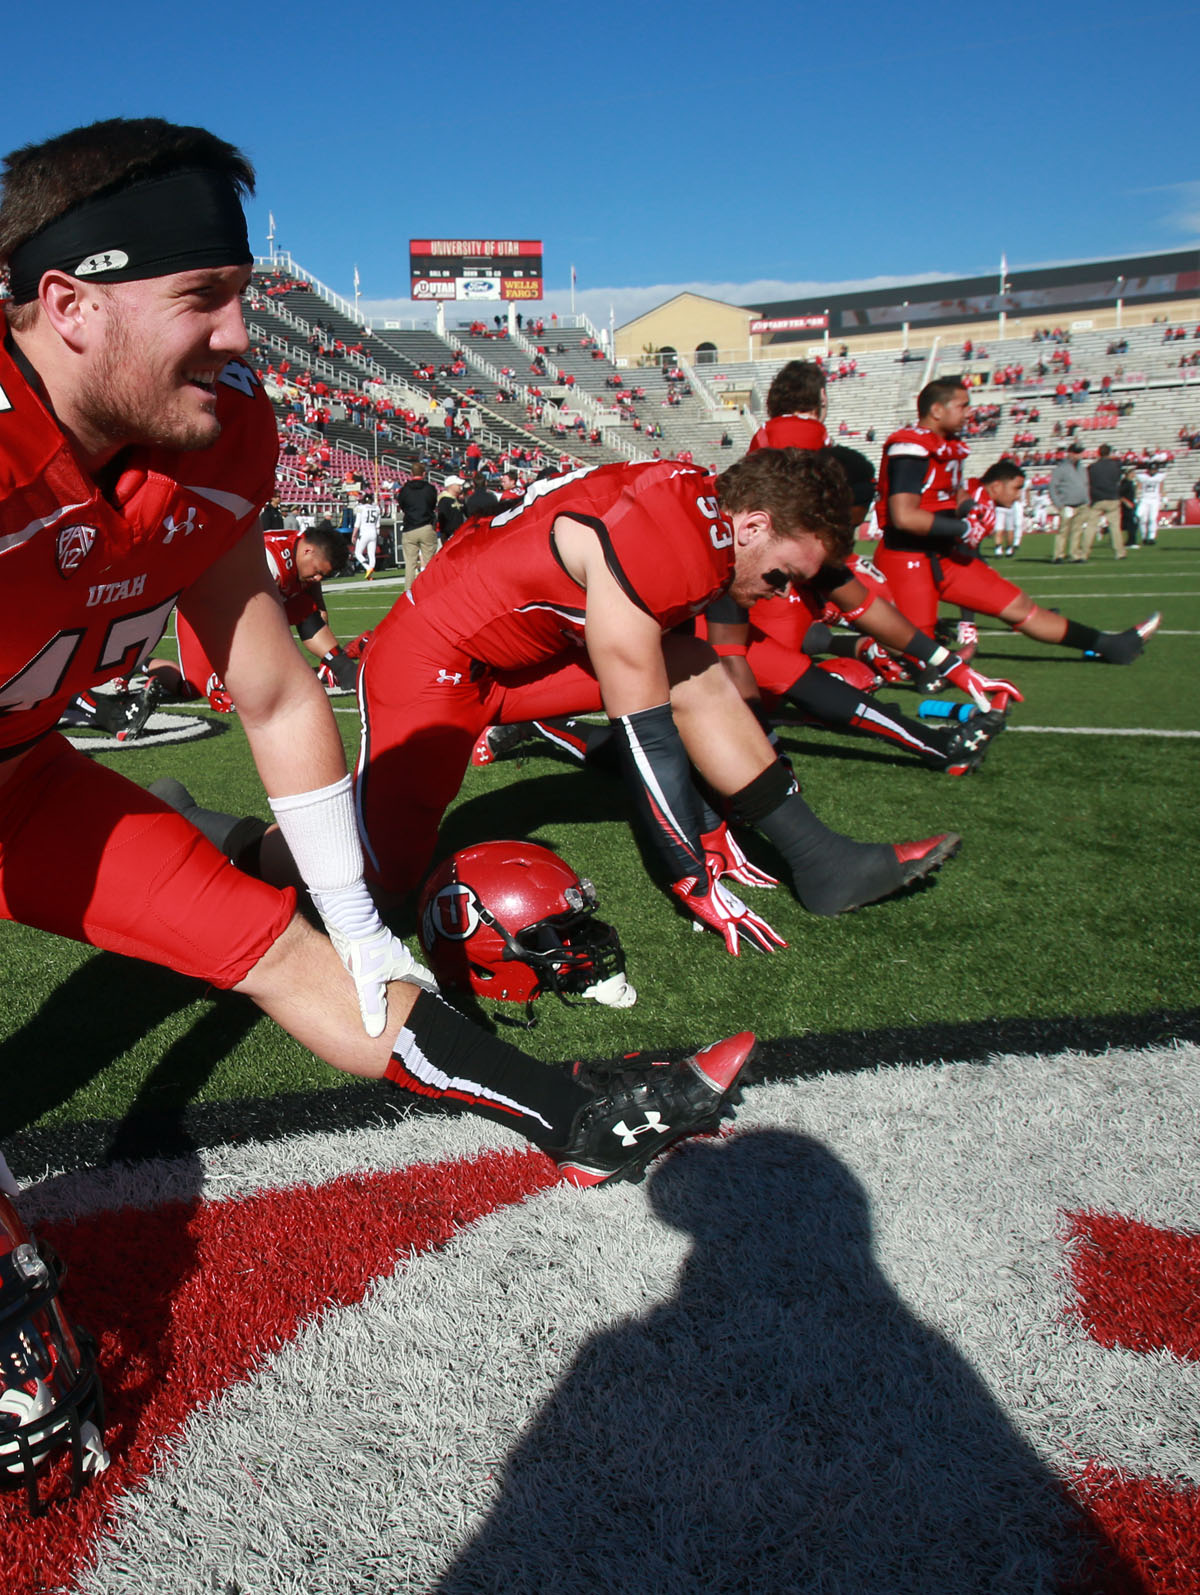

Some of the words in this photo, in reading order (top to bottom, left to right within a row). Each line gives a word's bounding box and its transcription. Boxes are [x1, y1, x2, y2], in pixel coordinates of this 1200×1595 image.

[430, 241, 482, 256] UNIVERSITY
[484, 241, 495, 256] OF
[497, 241, 520, 256] UTAH
[429, 282, 455, 293] UTAH
[504, 281, 538, 290] WELLS
[505, 289, 539, 299] FARGO
[218, 360, 260, 399] 4
[365, 509, 378, 524] 15
[696, 496, 734, 550] 53
[58, 525, 97, 559] PAC
[60, 547, 82, 569] 12
[85, 573, 147, 607] UTAH
[437, 892, 470, 934] U
